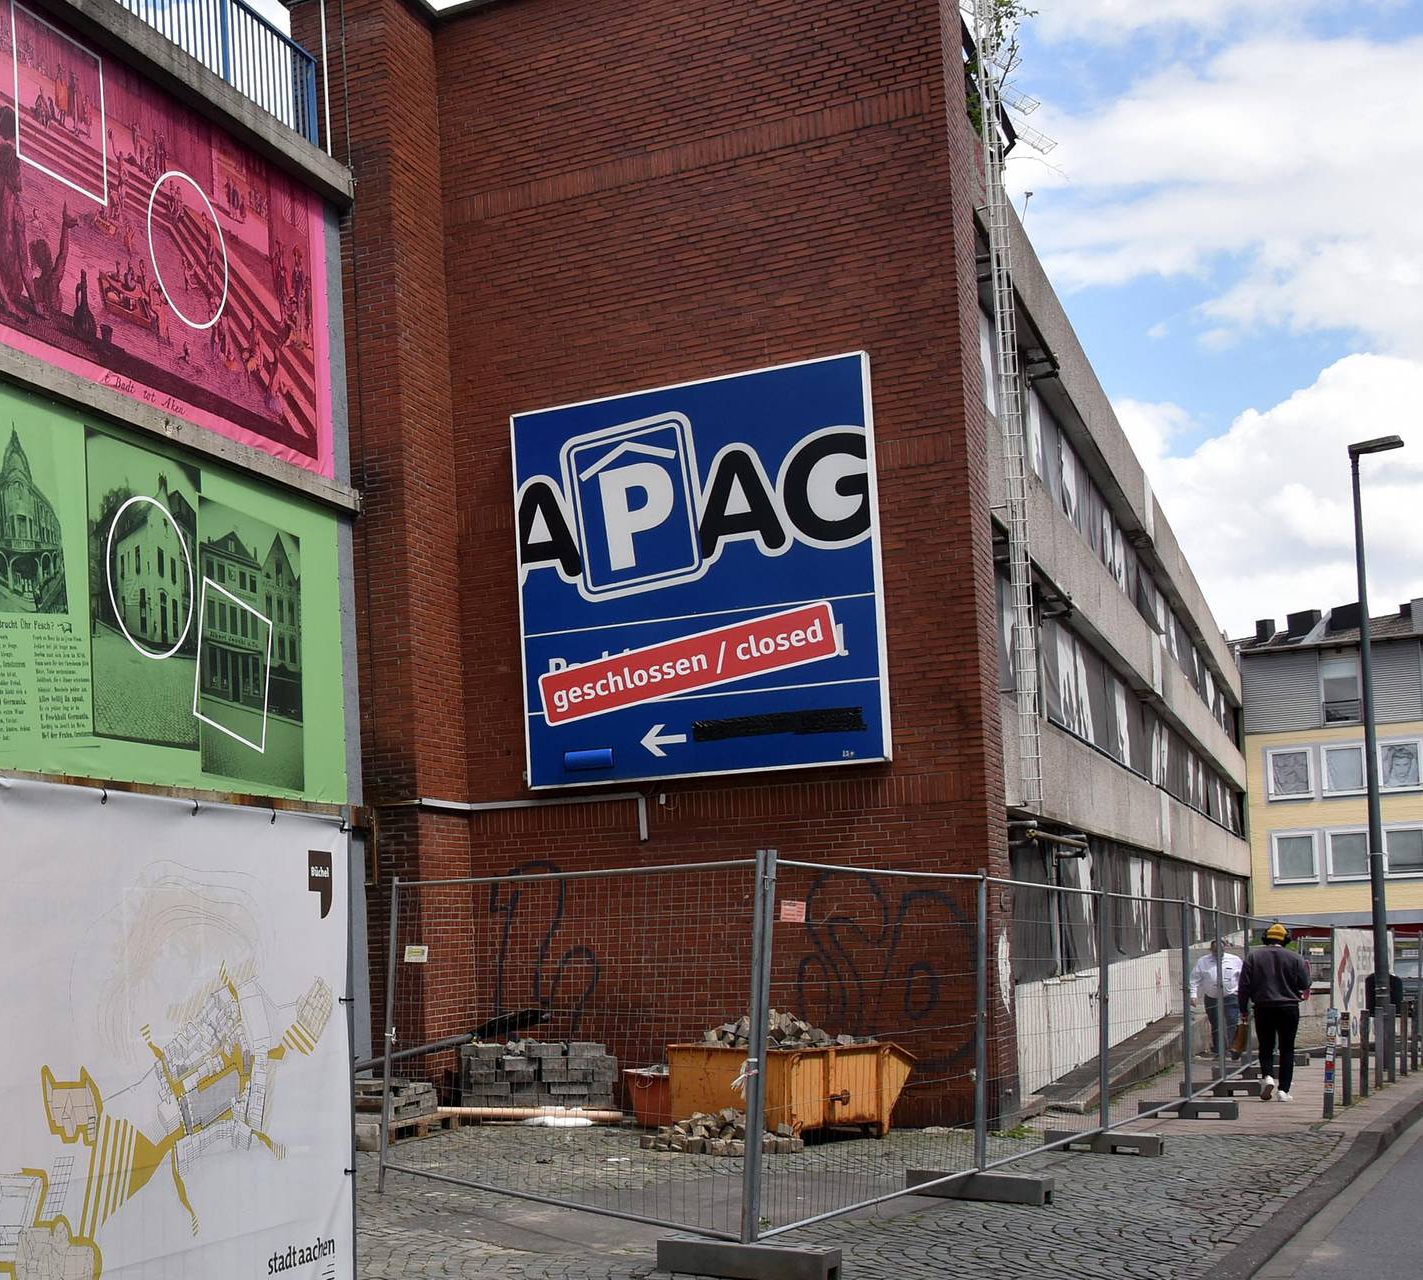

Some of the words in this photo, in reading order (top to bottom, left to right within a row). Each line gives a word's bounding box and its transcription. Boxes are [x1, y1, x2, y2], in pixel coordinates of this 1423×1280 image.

[518, 424, 871, 582] APAG
[553, 651, 708, 712] geschlossen
[715, 641, 727, 674] /
[736, 618, 824, 660] closed
[310, 865, 330, 878] Büchel
